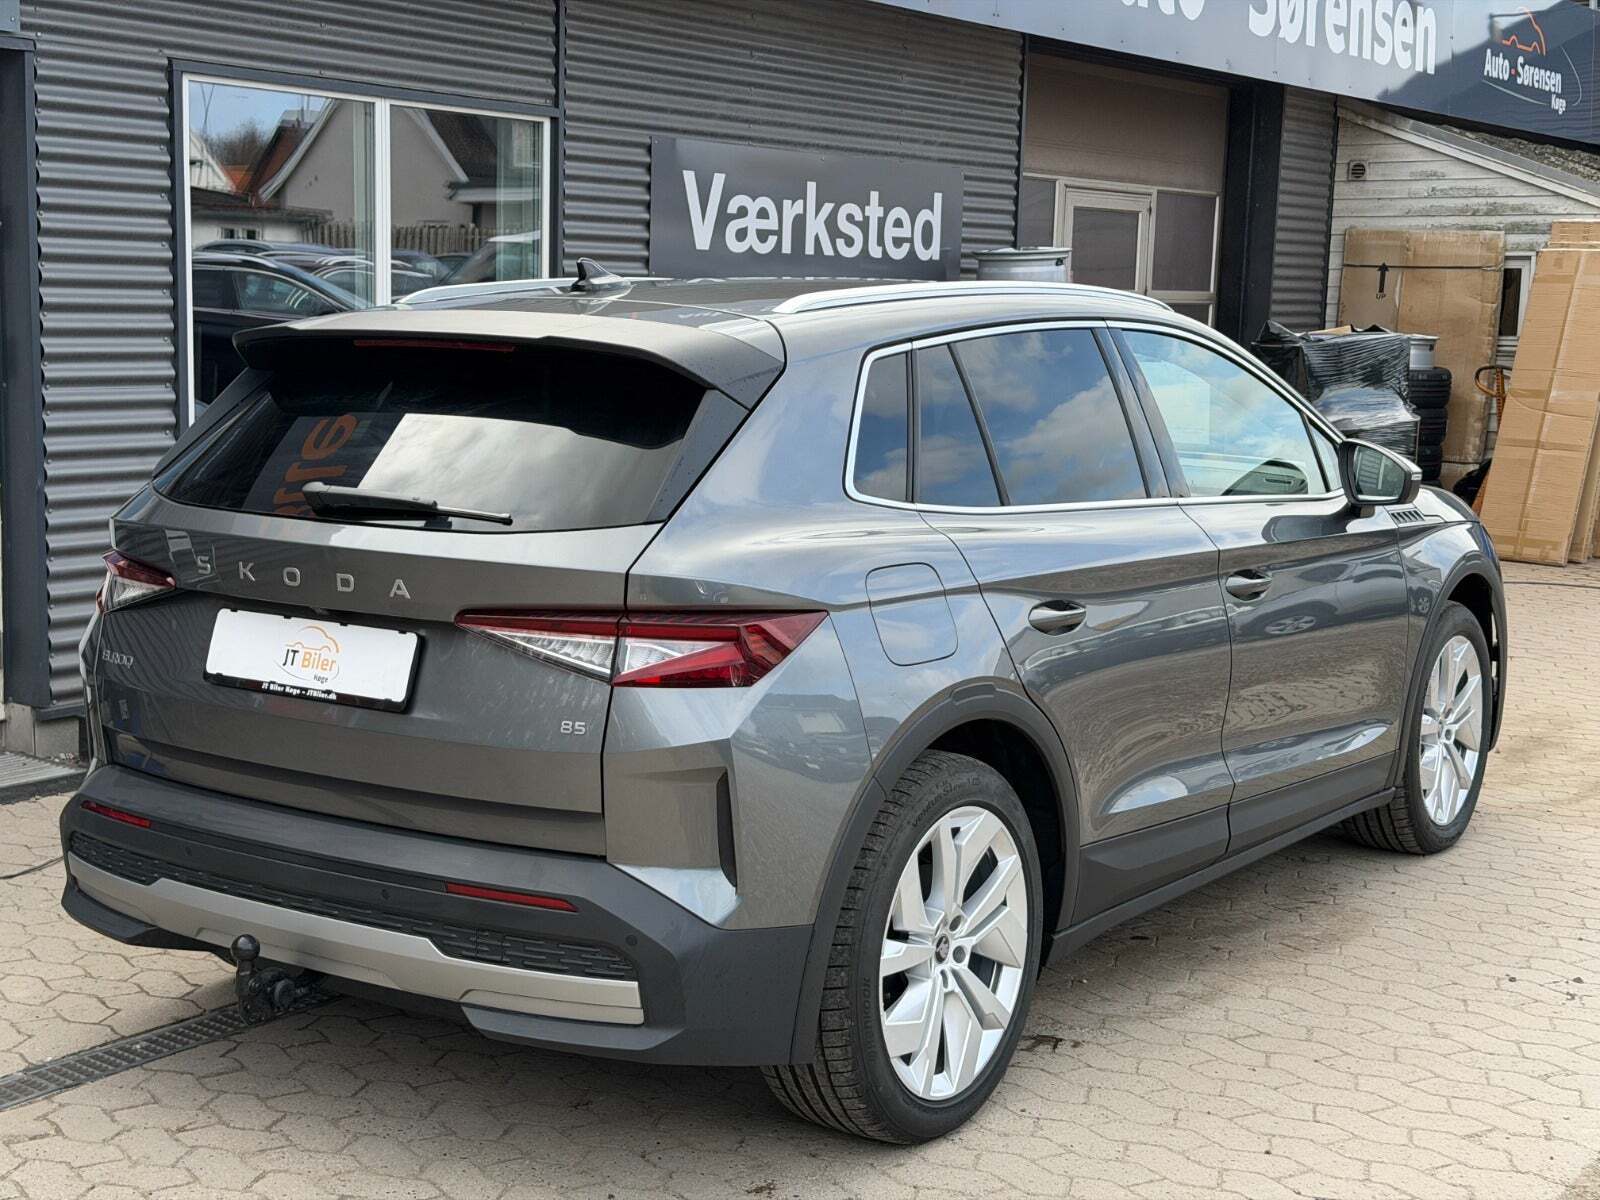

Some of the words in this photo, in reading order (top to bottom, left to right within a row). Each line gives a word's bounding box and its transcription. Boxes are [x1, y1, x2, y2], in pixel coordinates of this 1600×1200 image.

[1484, 48, 1510, 81] Auto
[1516, 55, 1562, 94] Sørensen
[682, 169, 943, 261] Værksted
[282, 649, 299, 666] JT
[301, 651, 336, 671] Biler
[560, 720, 586, 735] 85
